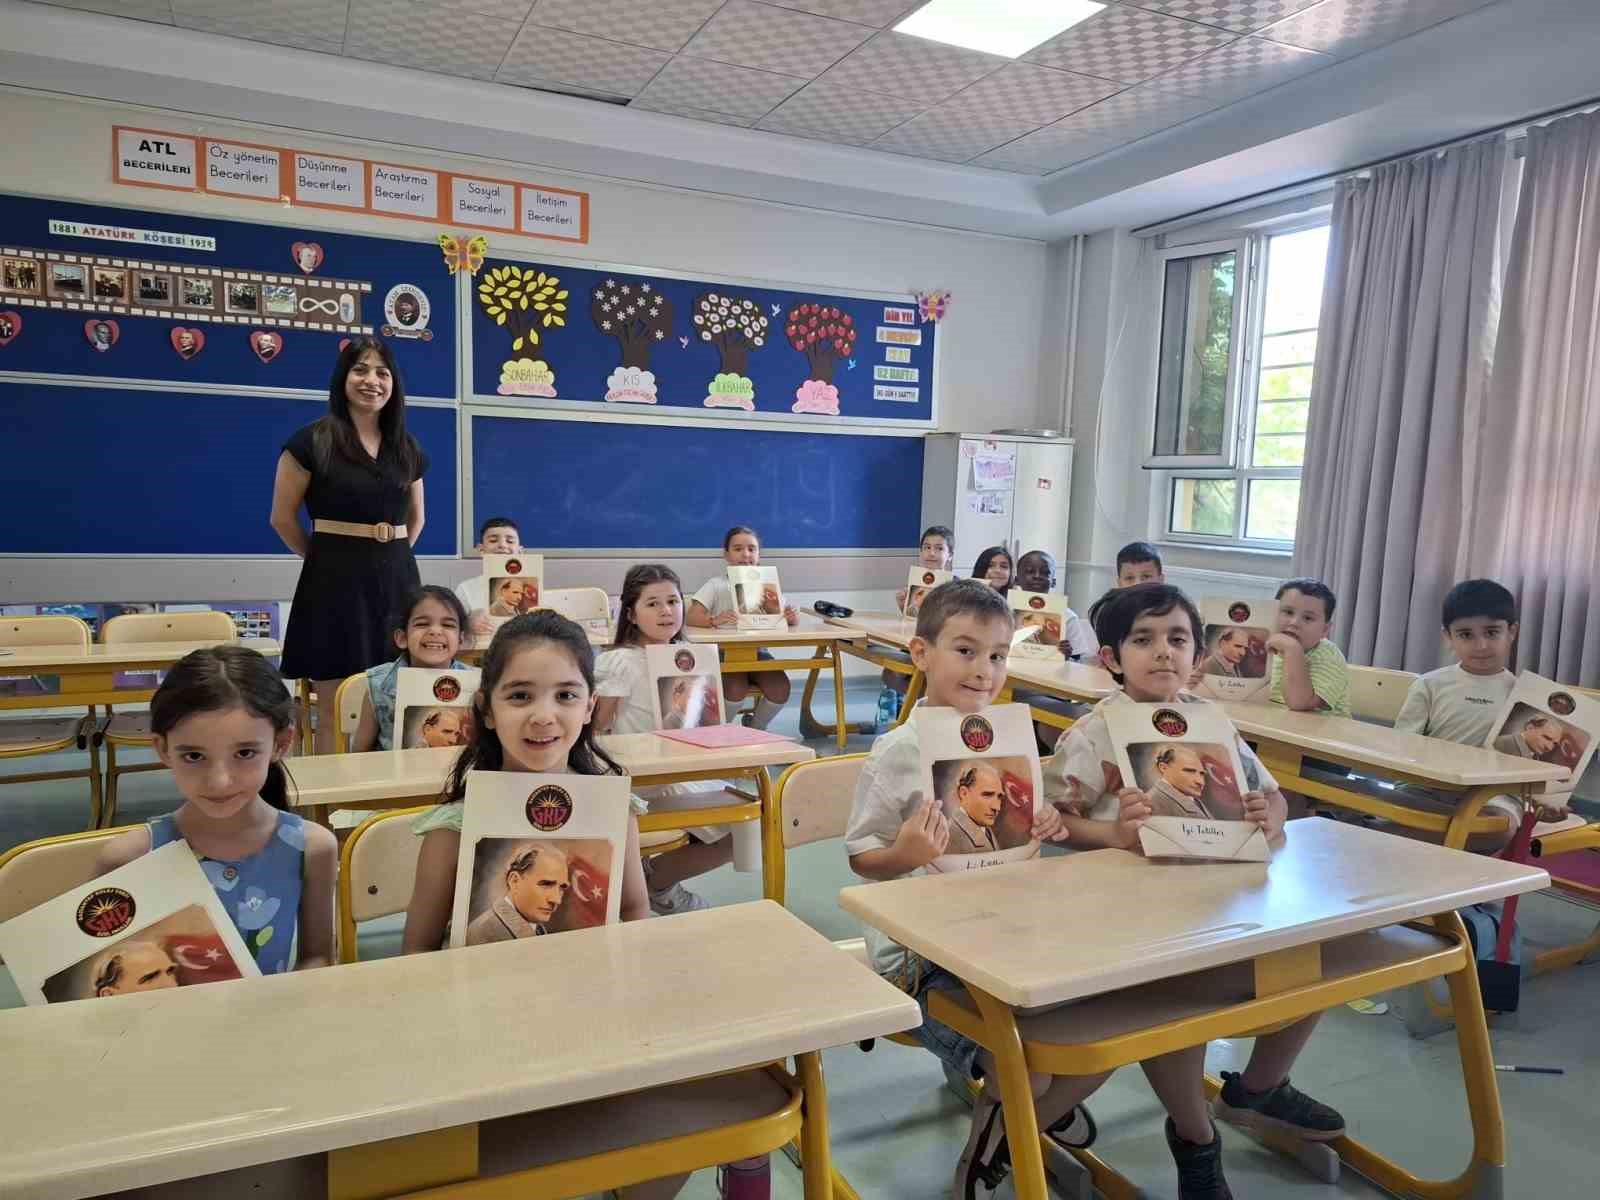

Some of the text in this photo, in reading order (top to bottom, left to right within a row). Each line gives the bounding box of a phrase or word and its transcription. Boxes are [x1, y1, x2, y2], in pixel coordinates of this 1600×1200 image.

[139, 140, 176, 156] ATL
[123, 159, 191, 174] BECERİLERİ
[233, 152, 278, 166] yönetim
[298, 157, 348, 174] Düşünme
[210, 164, 269, 184] Becerileri
[375, 168, 428, 185] Araştırma
[298, 176, 351, 192] Becerileri
[468, 182, 501, 200] Sosyal
[374, 186, 425, 202] Becerileri
[459, 200, 506, 216] Becerileri
[527, 210, 573, 225] Becerileri
[53, 223, 77, 234] 1881
[82, 225, 136, 240] ATATÜRK
